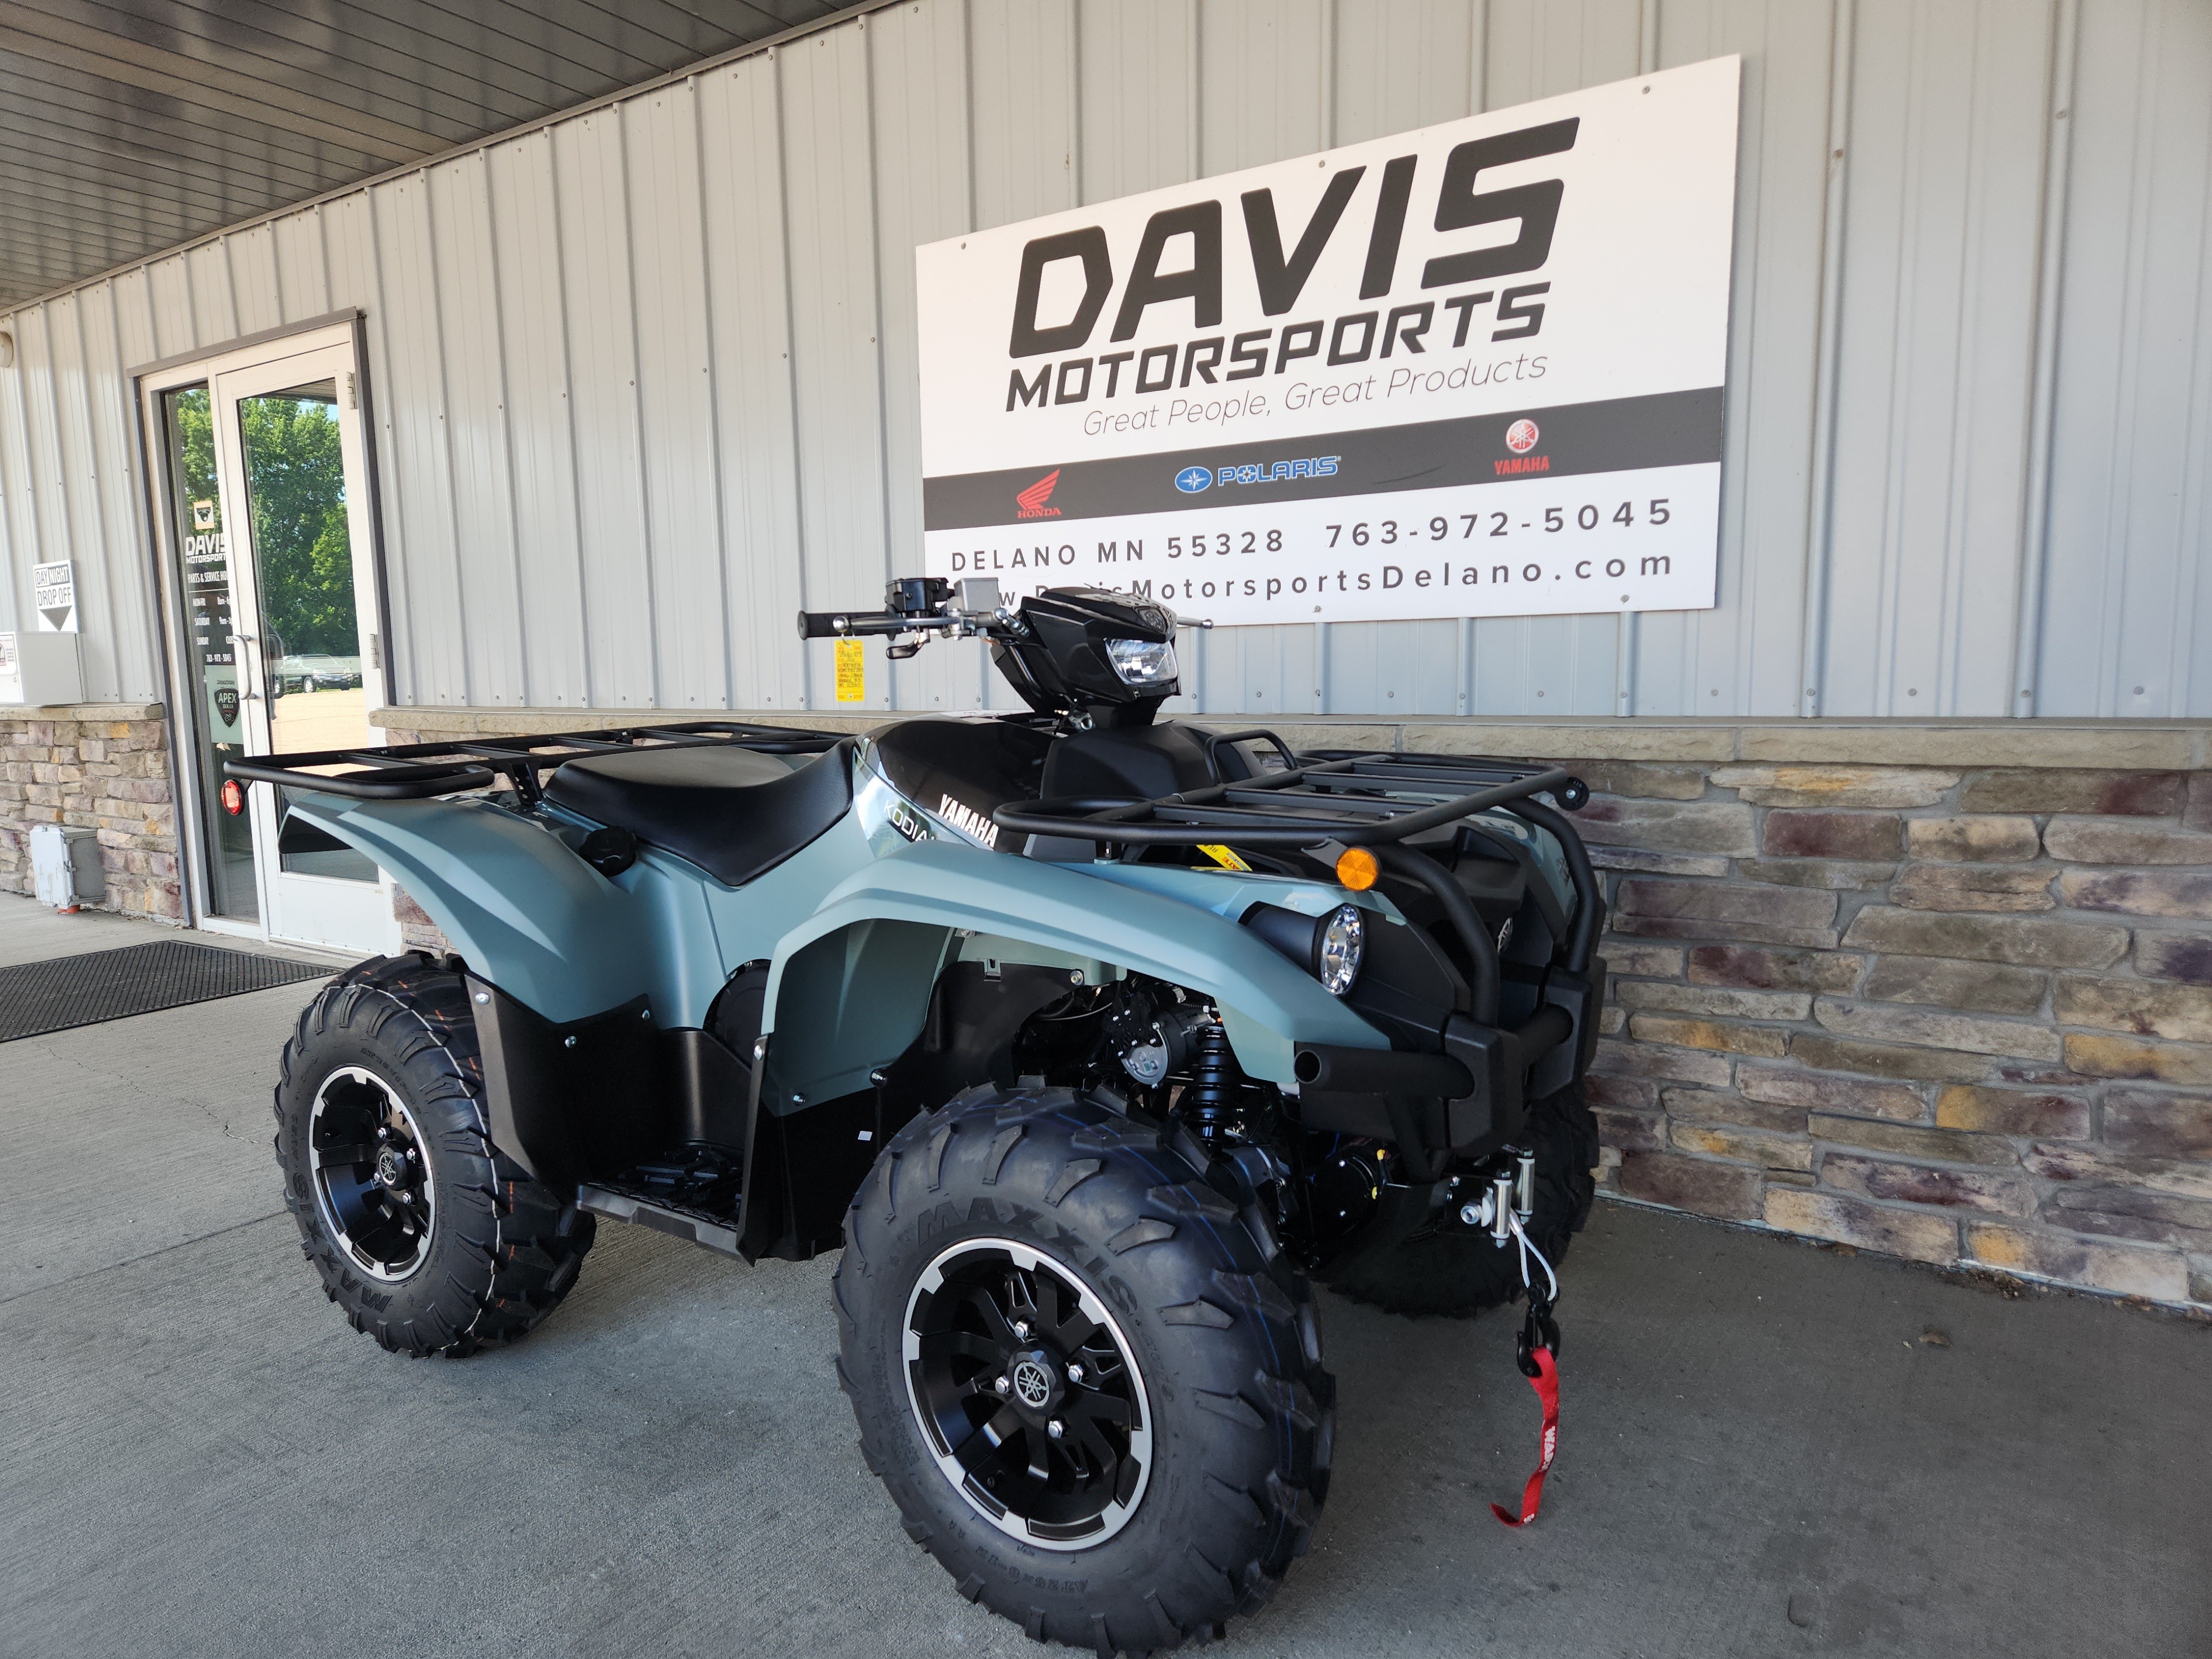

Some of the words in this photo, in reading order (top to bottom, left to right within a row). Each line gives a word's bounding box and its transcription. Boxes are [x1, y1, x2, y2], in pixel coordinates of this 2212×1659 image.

[1009, 117, 1580, 358] DAVIS
[1006, 282, 1551, 411] MOTORSPORTS
[1084, 405, 1160, 435] Great
[1168, 390, 1271, 426] People,
[1285, 375, 1377, 410] Great
[1386, 353, 1548, 398] Products
[1218, 456, 1338, 487] POLARIS
[1494, 455, 1550, 476] YAMAHA
[1017, 507, 1062, 519] HONDA
[952, 544, 1076, 572] DELANO
[1098, 539, 1144, 564] MN
[1167, 529, 1283, 559] 55328
[1325, 498, 1671, 549] 763-972-5045
[186, 553, 226, 564] MOTORSPORT
[36, 570, 48, 585] DAY
[48, 566, 69, 583] NIGHT
[187, 572, 200, 583] PARTS
[200, 573, 205, 583] &
[204, 571, 220, 582] SERVICE
[37, 588, 57, 607] DROP
[59, 586, 71, 604] OFF
[196, 637, 209, 645] SUNDAY
[218, 692, 237, 704] APEX
[883, 799, 935, 842] KODIA
[938, 793, 999, 848] YAMAHA
[293, 1172, 393, 1313] MAXXIS
[918, 1197, 1138, 1314] MAXXIS
